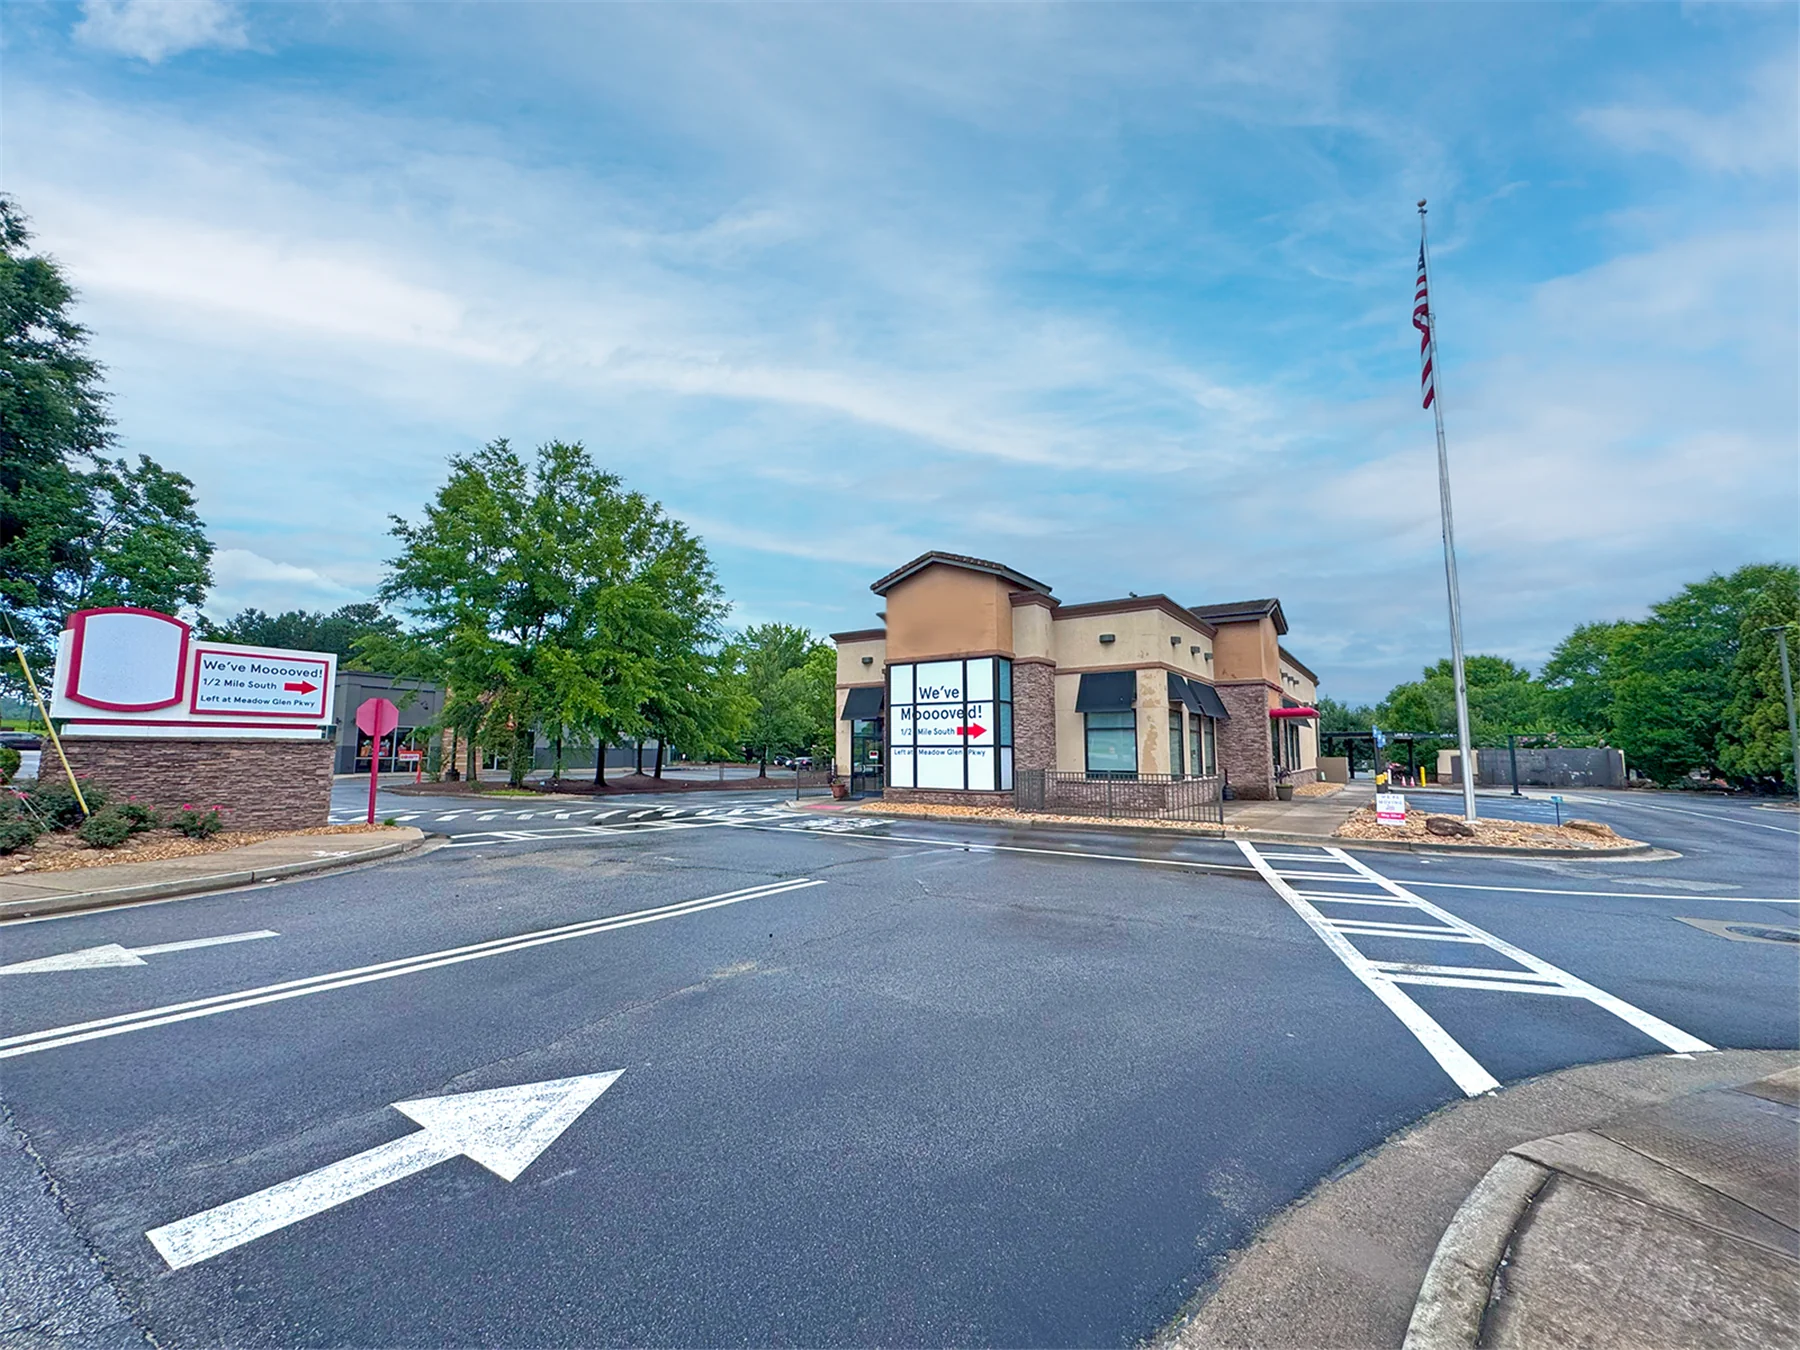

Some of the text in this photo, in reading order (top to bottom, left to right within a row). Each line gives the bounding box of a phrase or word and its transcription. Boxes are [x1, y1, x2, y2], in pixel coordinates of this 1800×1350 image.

[203, 659, 323, 678] We've Mooooved!
[203, 678, 277, 690] 1/2 Mile South
[919, 685, 960, 700] We've
[200, 694, 220, 703] Left
[233, 696, 271, 705] Meadow
[272, 698, 292, 706] Glen
[293, 699, 315, 708] Pkwy
[901, 704, 982, 721] Mooooved!
[900, 727, 955, 736] 1/2 Mile South
[947, 748, 963, 756] Glen
[968, 748, 986, 757] Pkwy
